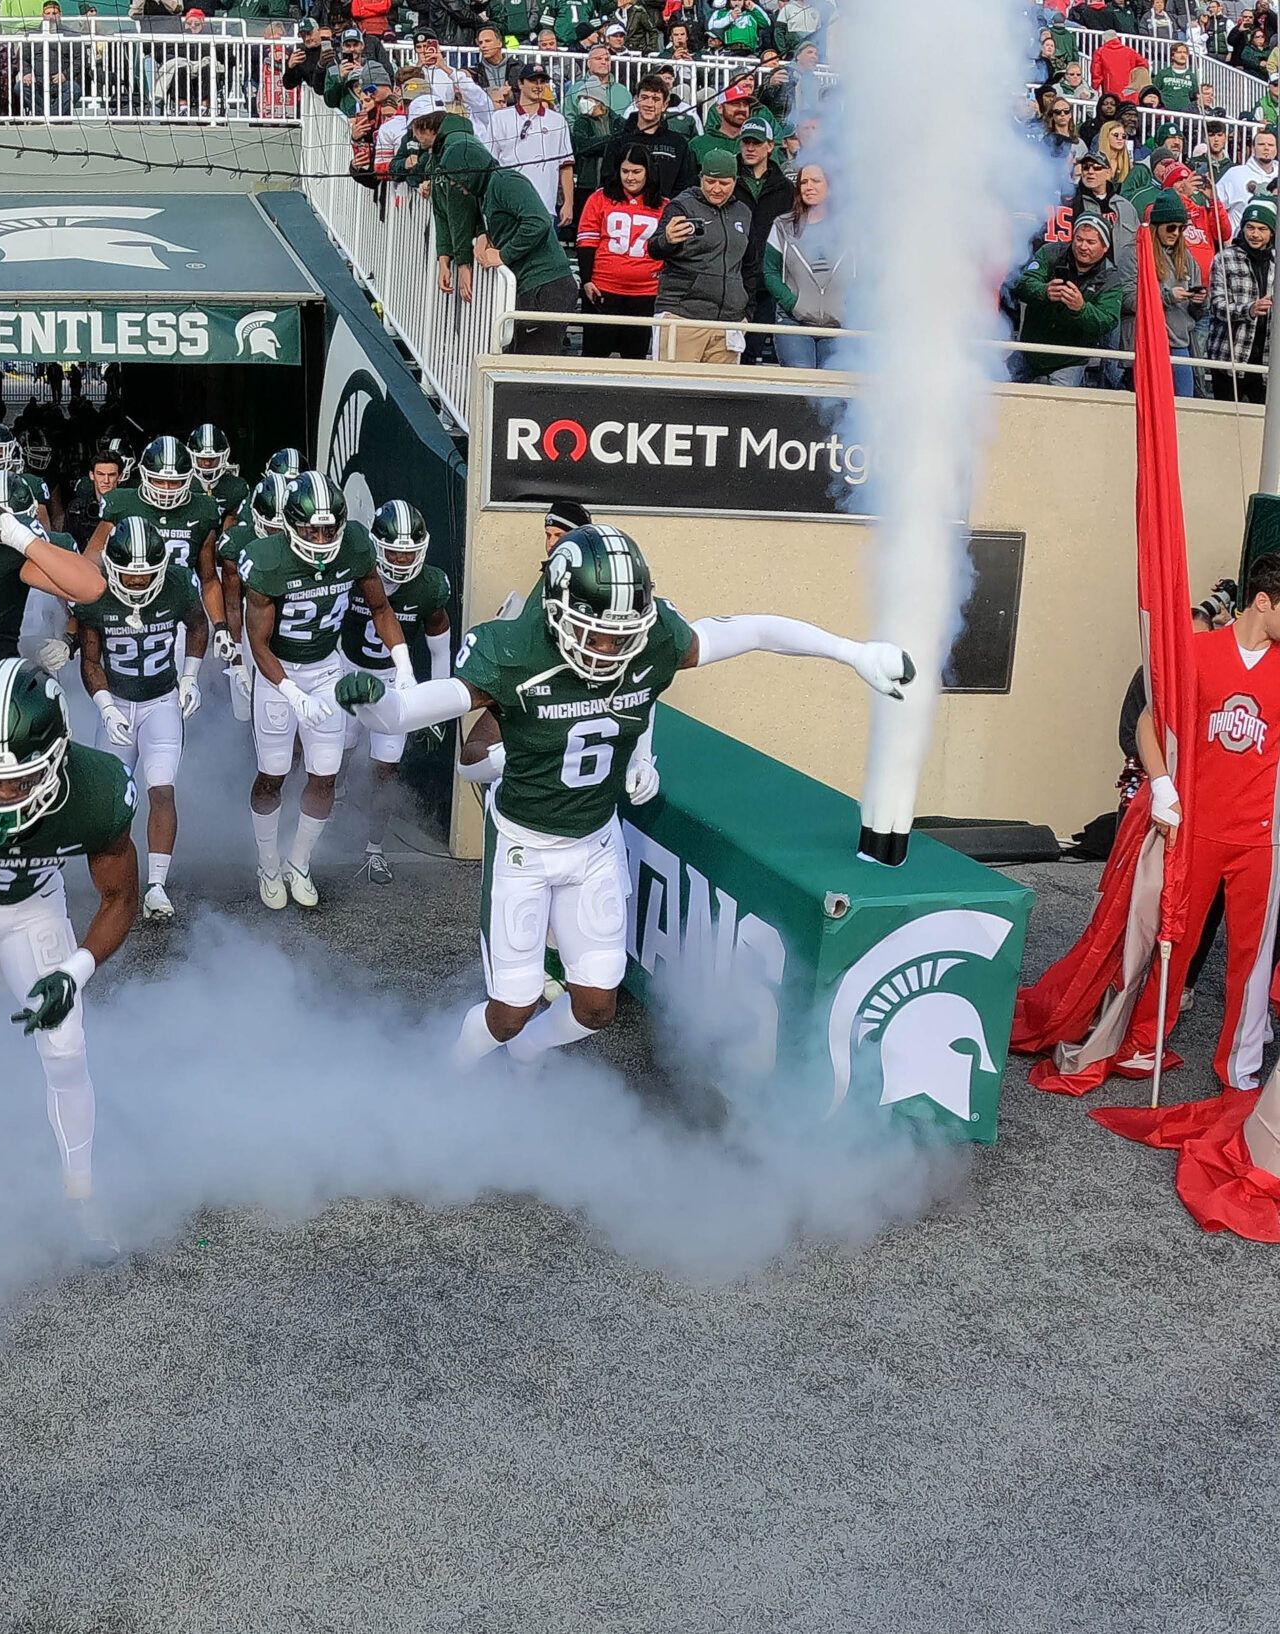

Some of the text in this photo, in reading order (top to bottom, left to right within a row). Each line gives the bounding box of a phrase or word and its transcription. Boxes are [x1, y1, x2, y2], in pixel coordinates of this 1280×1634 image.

[607, 211, 658, 258] 97
[506, 418, 871, 485] ROCKET Mortg
[170, 529, 192, 539] STATE
[279, 591, 350, 641] 24
[285, 586, 329, 601] MICHIGAN
[150, 620, 174, 632] STATE
[106, 631, 175, 677] 22
[537, 687, 653, 721] MICHIGAN STATE
[560, 716, 620, 789] 6
